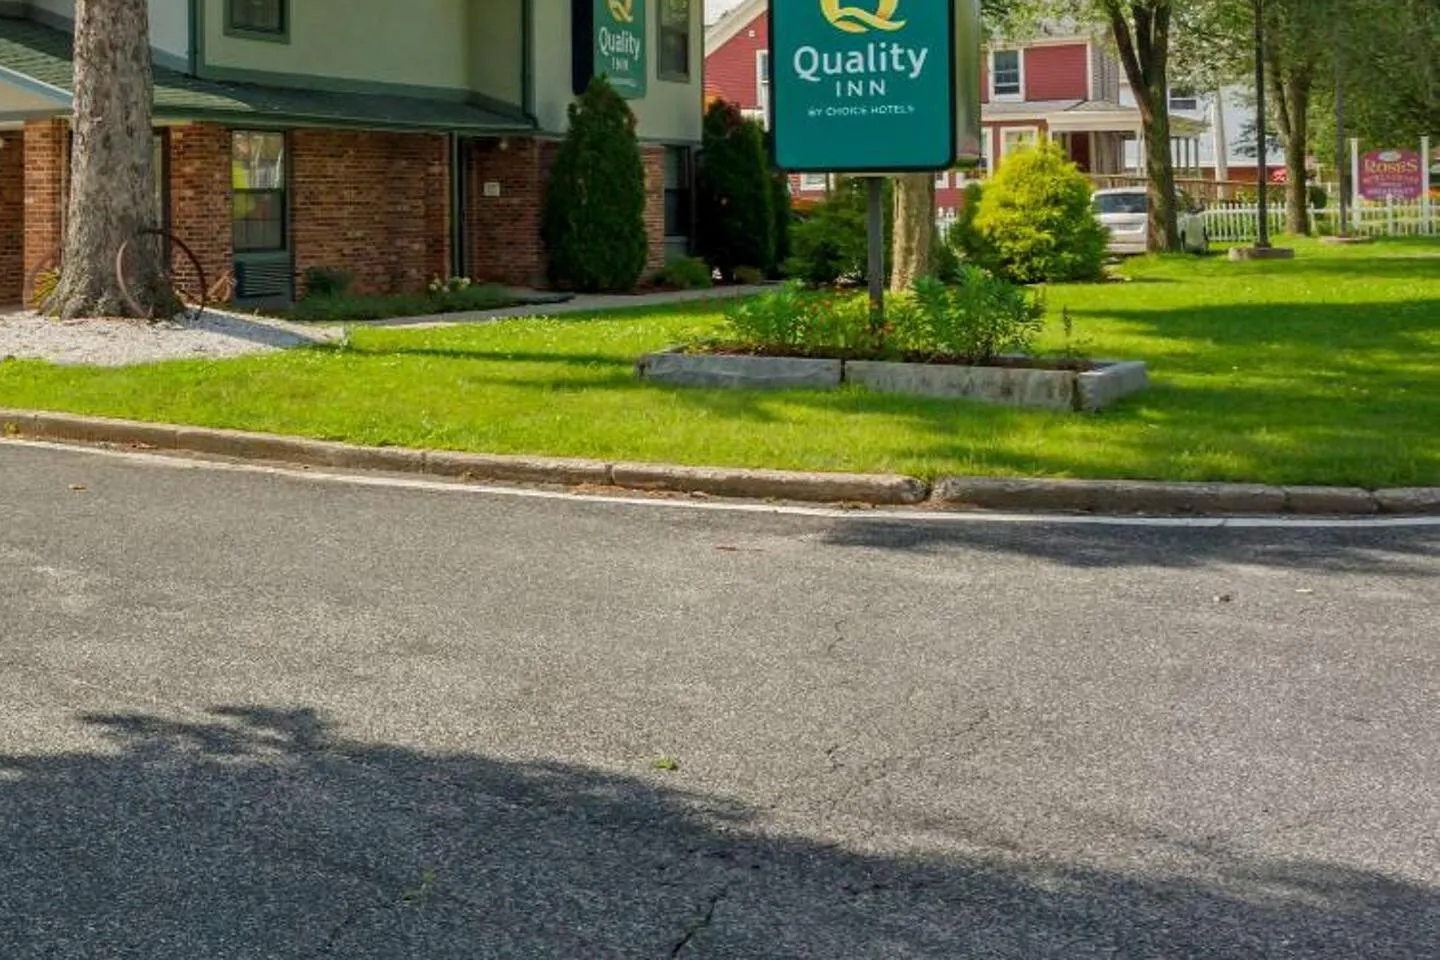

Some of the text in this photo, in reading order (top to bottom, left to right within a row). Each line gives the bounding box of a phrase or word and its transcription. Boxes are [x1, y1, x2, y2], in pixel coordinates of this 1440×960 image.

[599, 27, 640, 61] Quality
[793, 42, 928, 81] Quality
[835, 79, 886, 97] INN
[807, 105, 915, 117] BY CHOICE HOTELS
